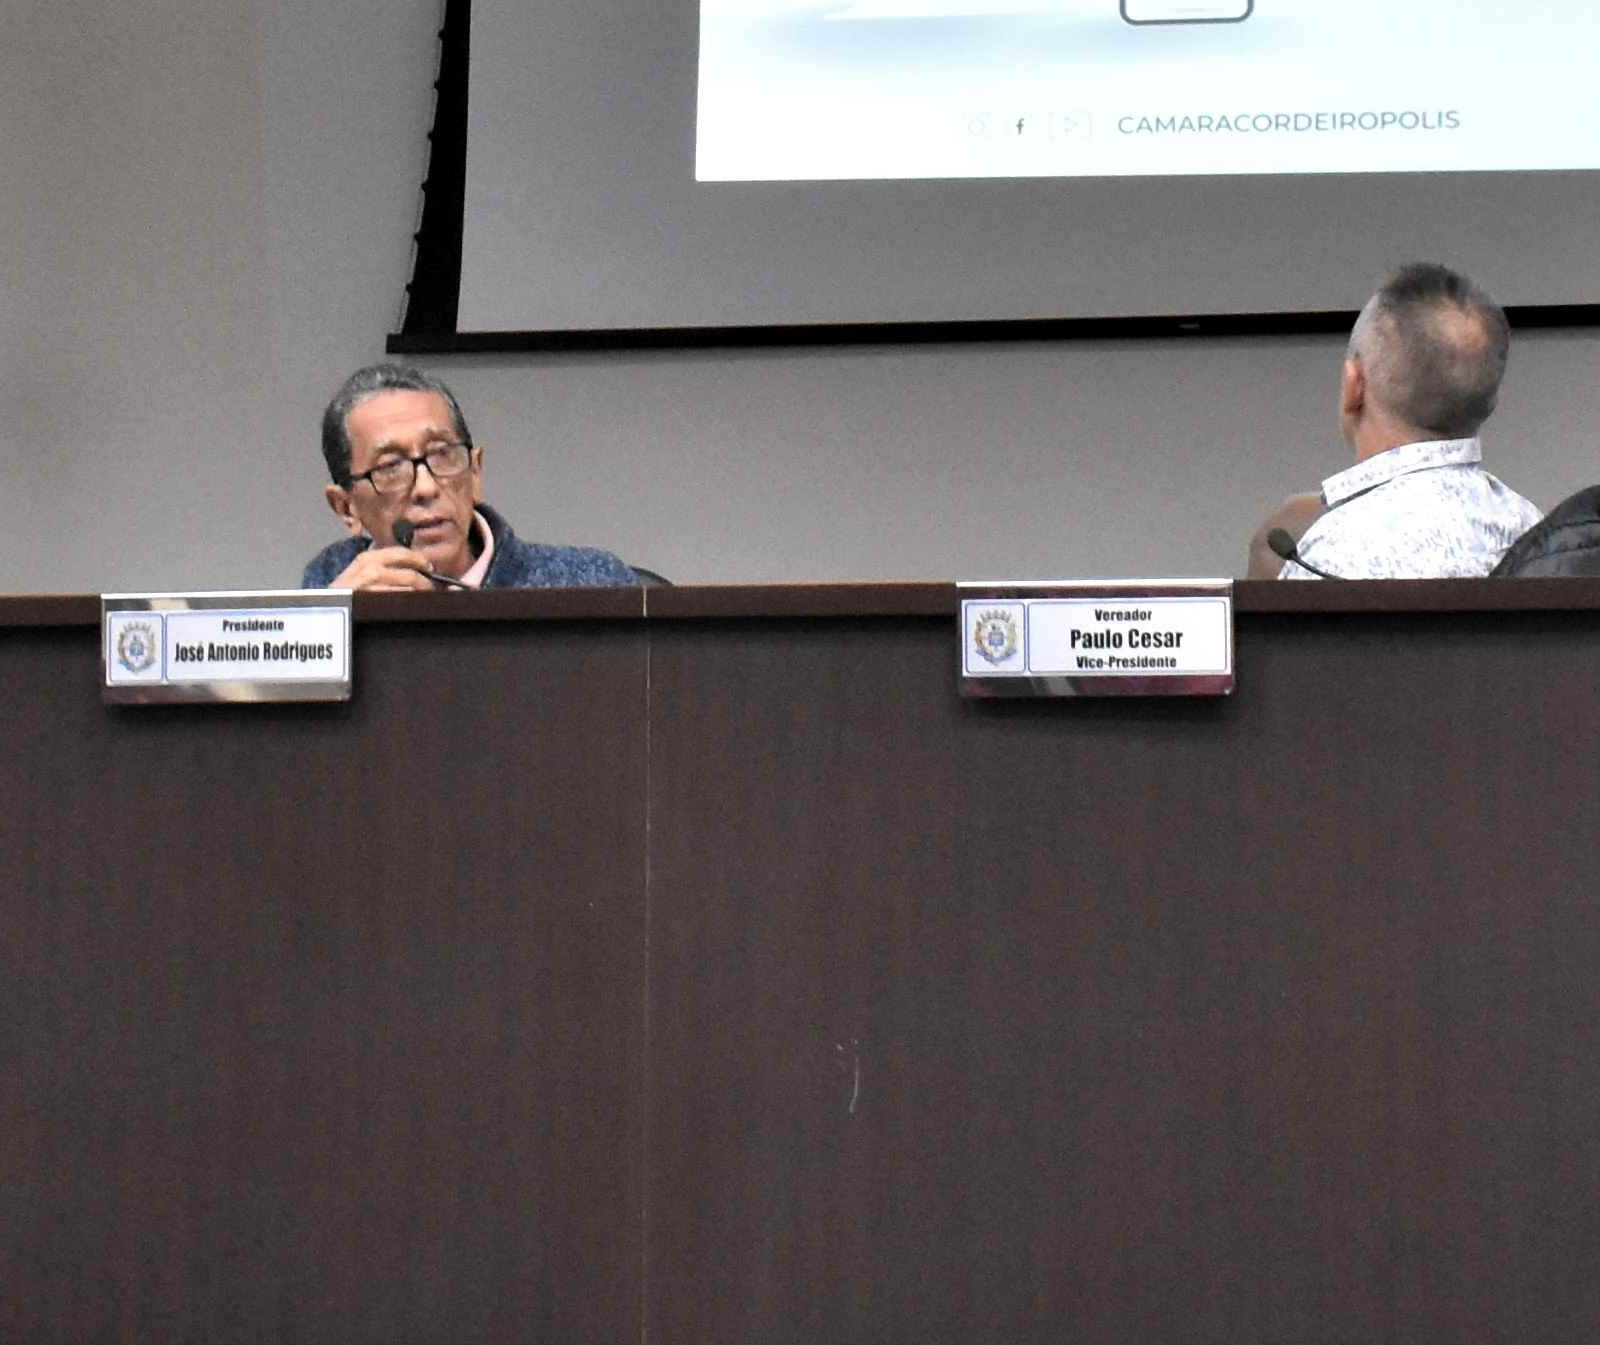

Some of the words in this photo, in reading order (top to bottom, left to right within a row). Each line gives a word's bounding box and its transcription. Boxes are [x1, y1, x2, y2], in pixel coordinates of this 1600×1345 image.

[1117, 109, 1461, 134] CAMARACORDEIROPOLIS
[1094, 608, 1153, 622] Vereador
[222, 619, 285, 632] Presidente
[1070, 628, 1123, 649] Paulo
[1128, 628, 1184, 649] Cesar
[174, 641, 205, 663] José
[207, 642, 260, 662] Antonio
[263, 640, 334, 662] Rodrigues
[1075, 654, 1177, 669] Vice-Presidente
